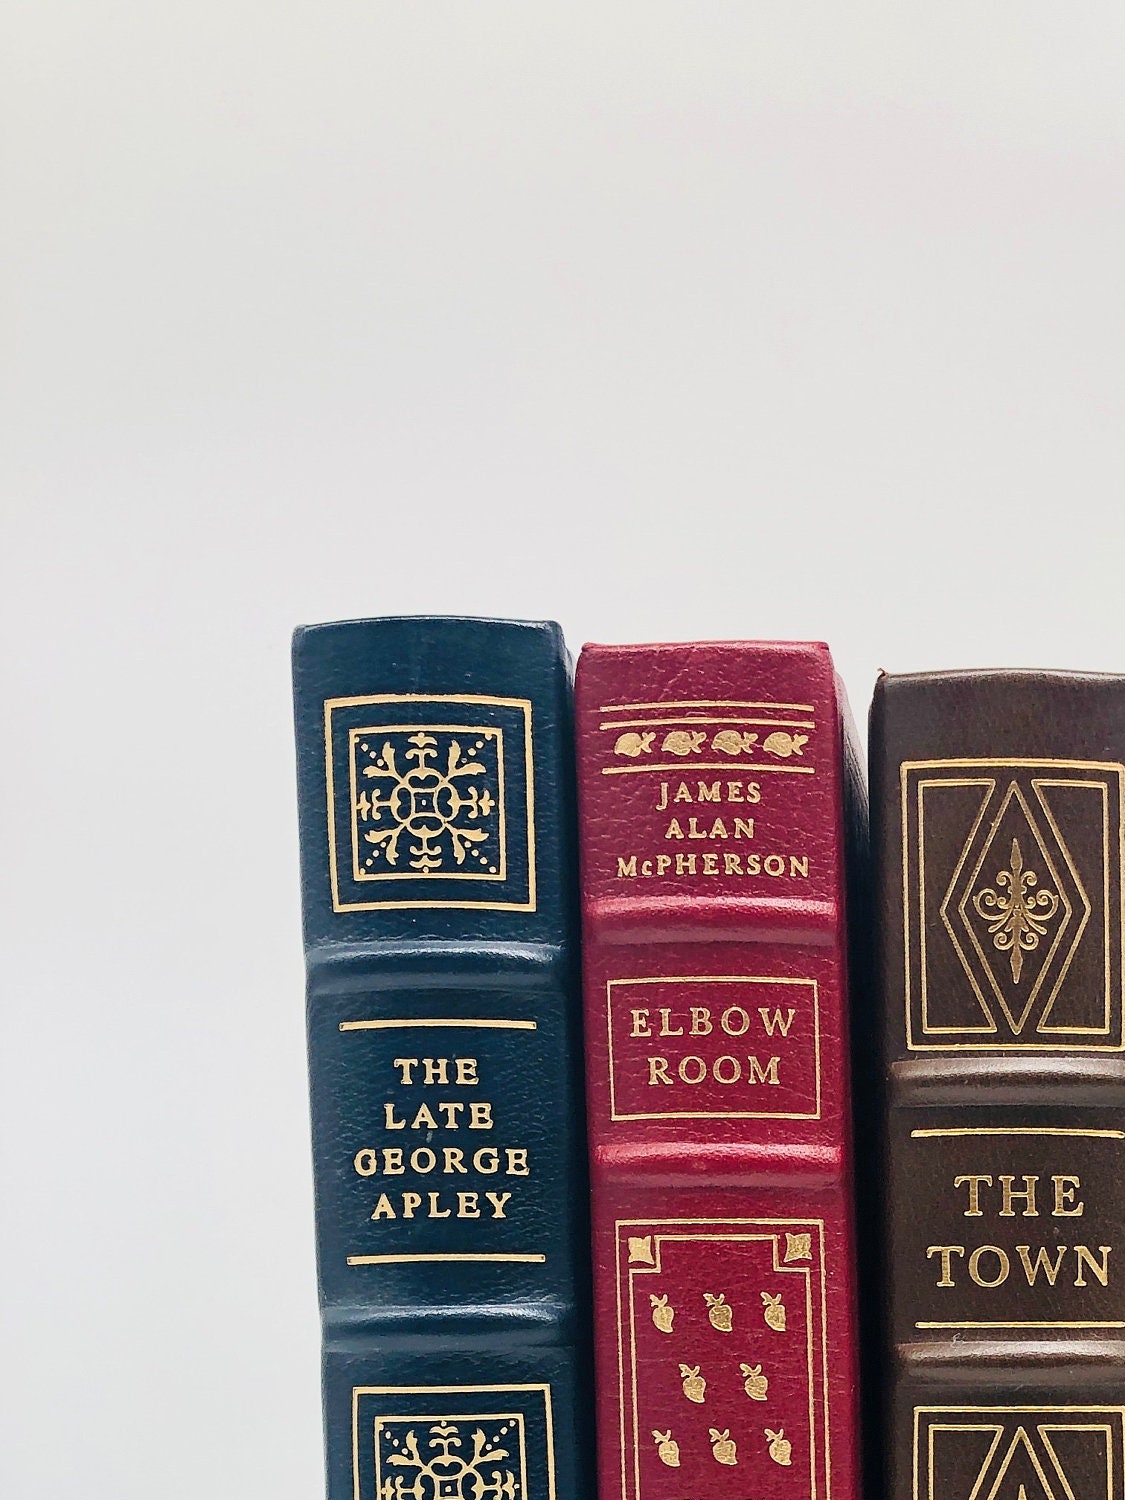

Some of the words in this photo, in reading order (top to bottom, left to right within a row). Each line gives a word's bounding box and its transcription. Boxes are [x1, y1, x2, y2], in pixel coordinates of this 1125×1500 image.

[655, 780, 761, 812] JAMES
[664, 817, 755, 840] ALAN
[617, 853, 809, 878] McPHERSON
[629, 1006, 796, 1038] ELBOW
[393, 1058, 480, 1085] THE
[647, 1055, 781, 1086] ROOM
[383, 1102, 494, 1130] LATE
[353, 1147, 530, 1177] GEORGE
[370, 1192, 512, 1221] APLEY
[953, 1174, 1085, 1217] THE
[925, 1244, 1113, 1288] TOWN
